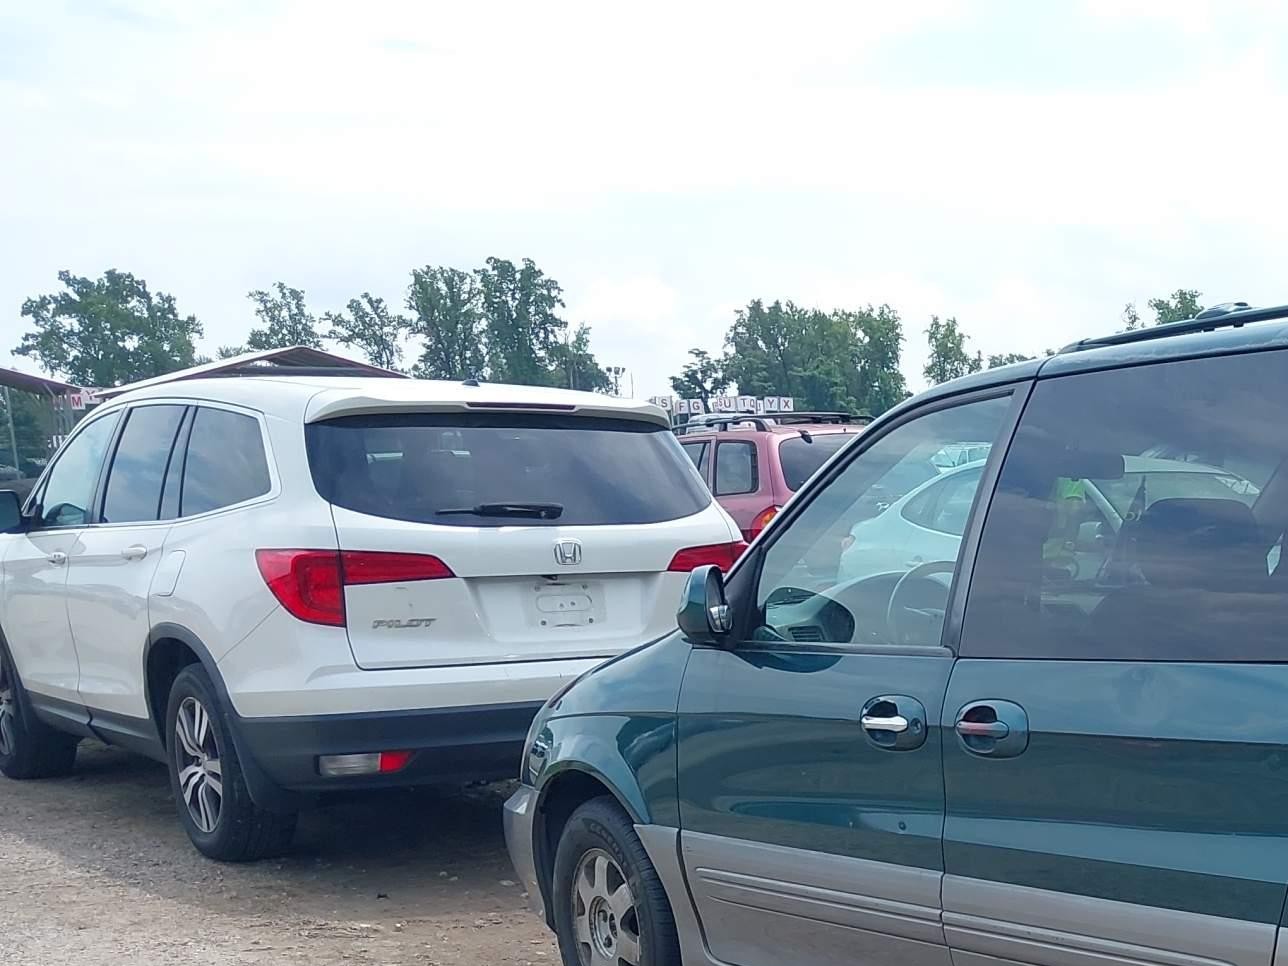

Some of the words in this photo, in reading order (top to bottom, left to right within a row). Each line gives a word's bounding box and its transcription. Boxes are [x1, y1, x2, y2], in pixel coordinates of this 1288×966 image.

[71, 396, 82, 407] M
[660, 398, 668, 408] S
[692, 401, 700, 410] G
[724, 399, 732, 408] U
[767, 399, 776, 409] Y
[783, 399, 791, 409] X
[372, 618, 436, 629] PILOT
